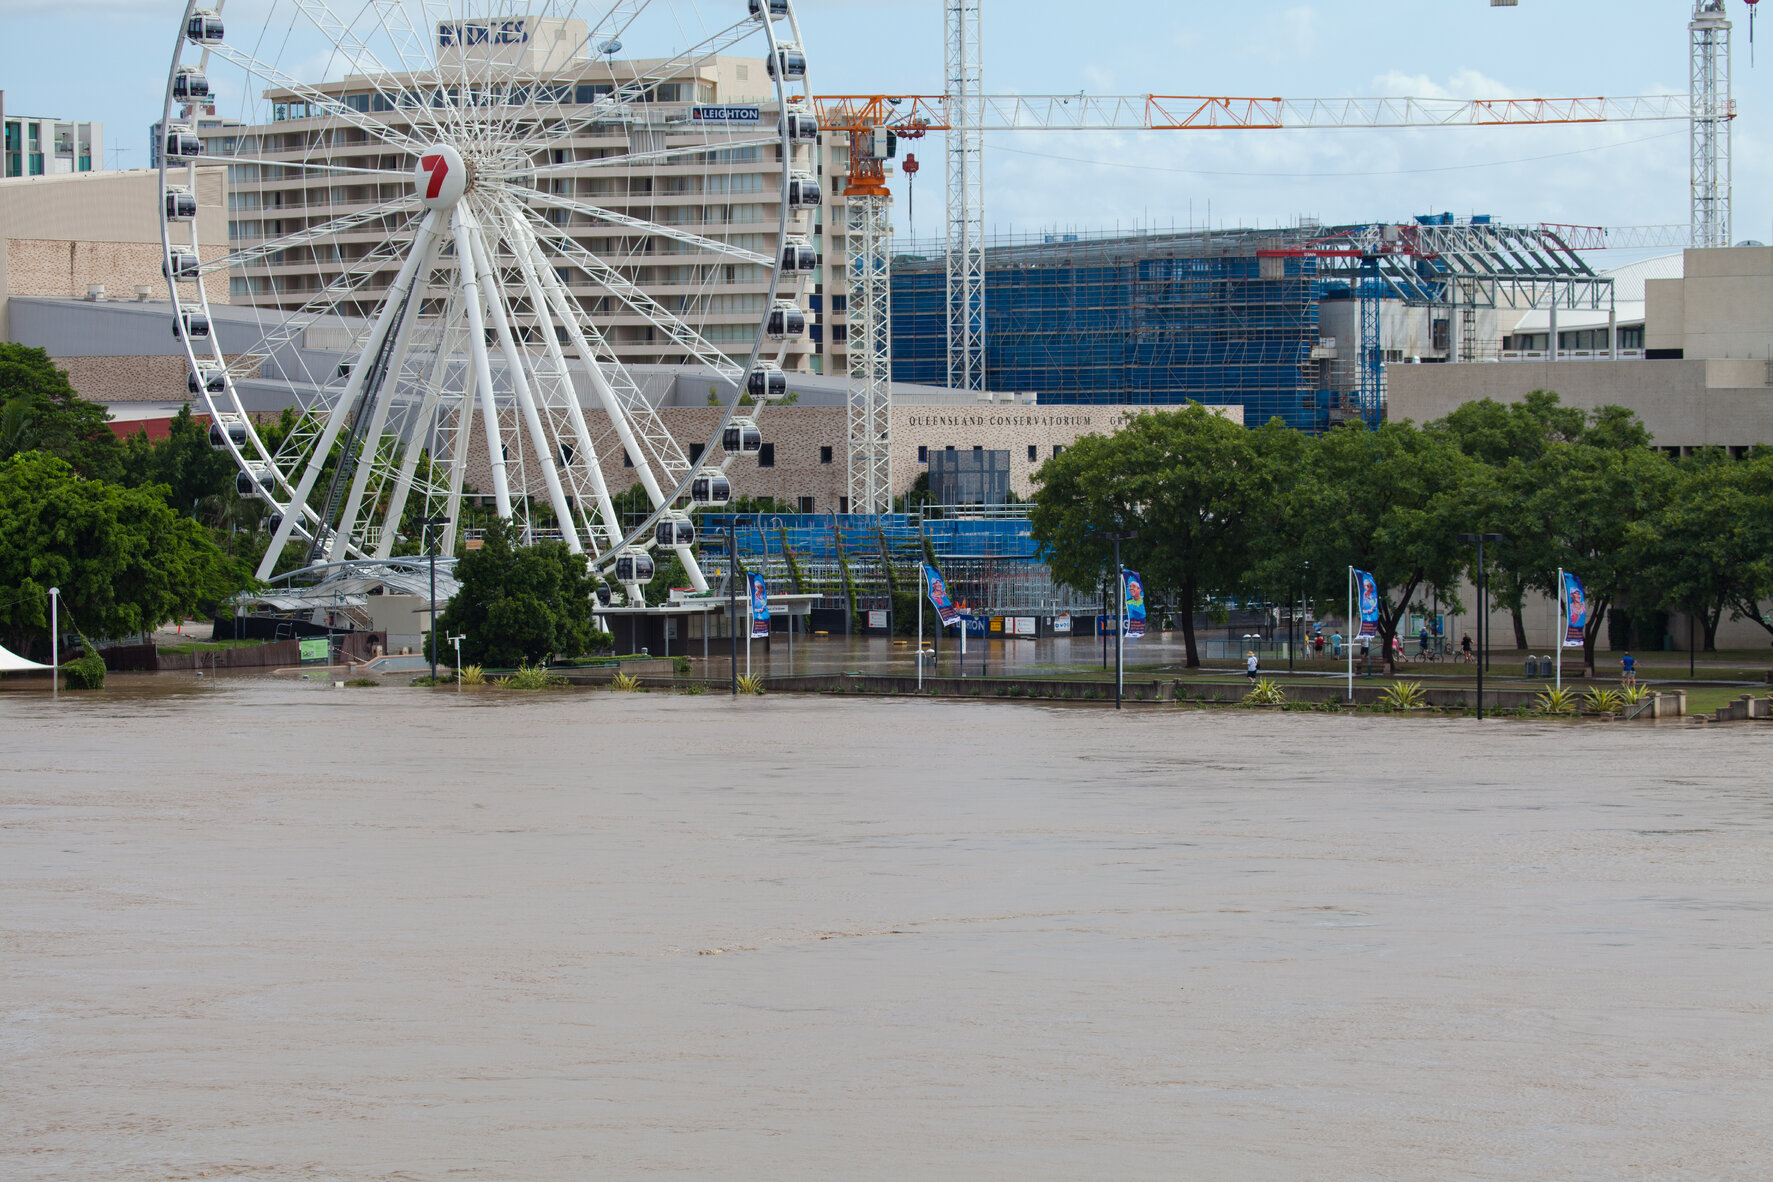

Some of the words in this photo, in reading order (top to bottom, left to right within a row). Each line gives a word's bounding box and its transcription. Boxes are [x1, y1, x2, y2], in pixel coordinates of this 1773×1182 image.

[439, 20, 528, 47] RYDGES
[703, 109, 758, 119] LEIGHTON
[420, 154, 449, 199] 7
[909, 416, 984, 426] QUEENSLAND
[990, 416, 1091, 426] CONSERVATORIUM
[1110, 416, 1129, 426] GRI
